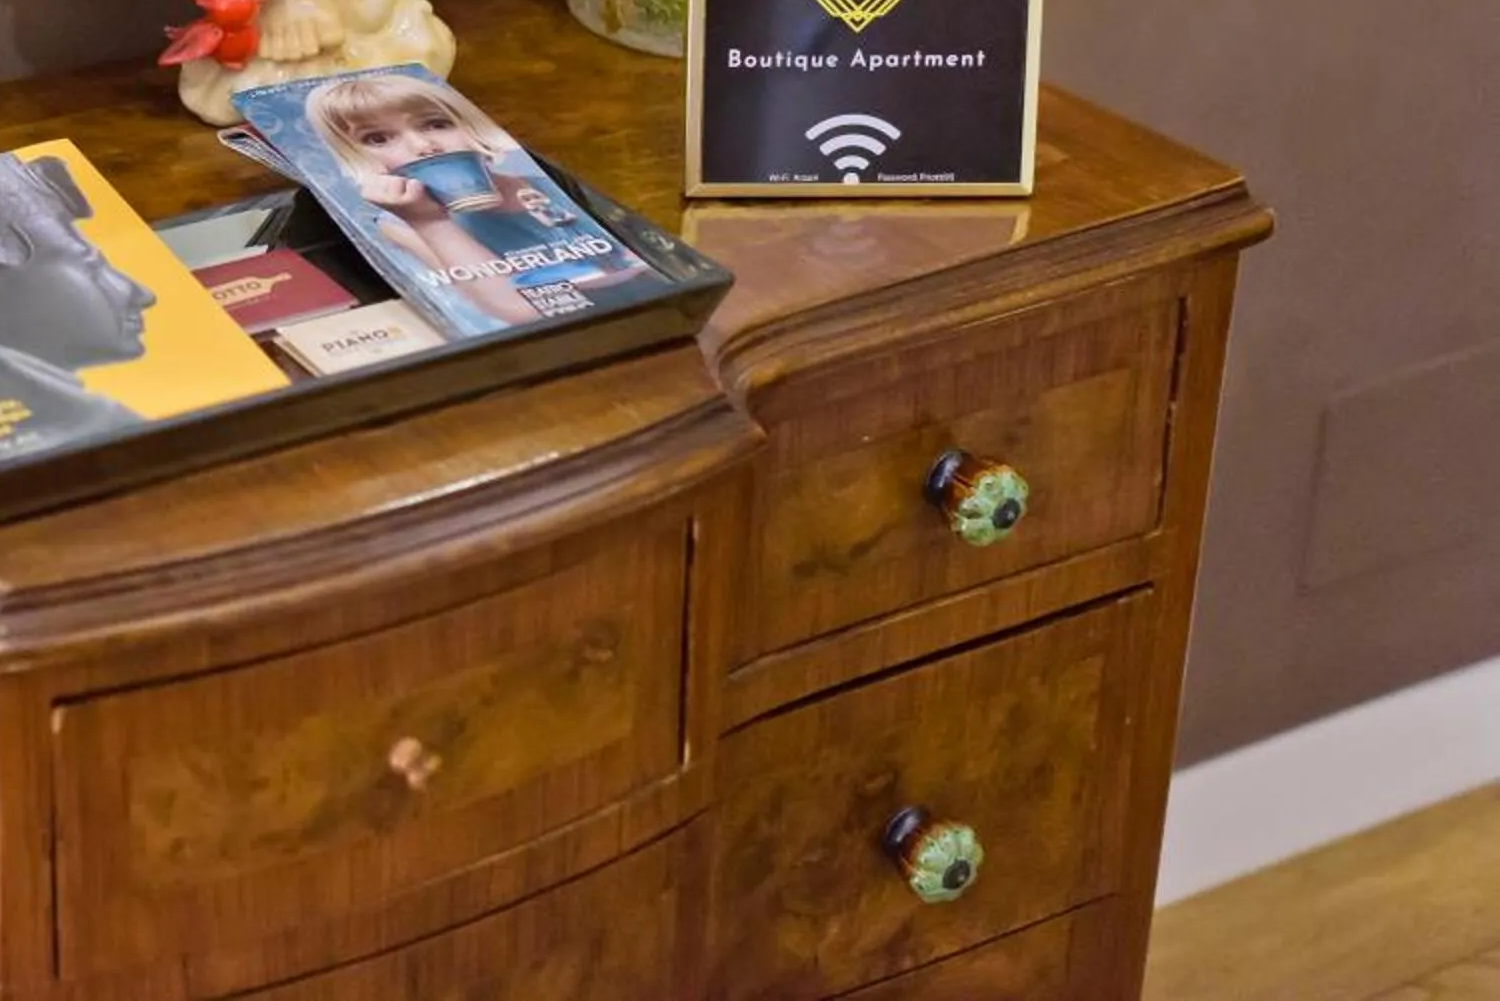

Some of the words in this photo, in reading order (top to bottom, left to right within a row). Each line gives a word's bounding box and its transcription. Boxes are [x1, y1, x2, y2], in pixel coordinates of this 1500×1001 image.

[728, 48, 839, 72] Boutique
[851, 47, 987, 72] Apartment
[418, 237, 613, 287] WONDERLAND
